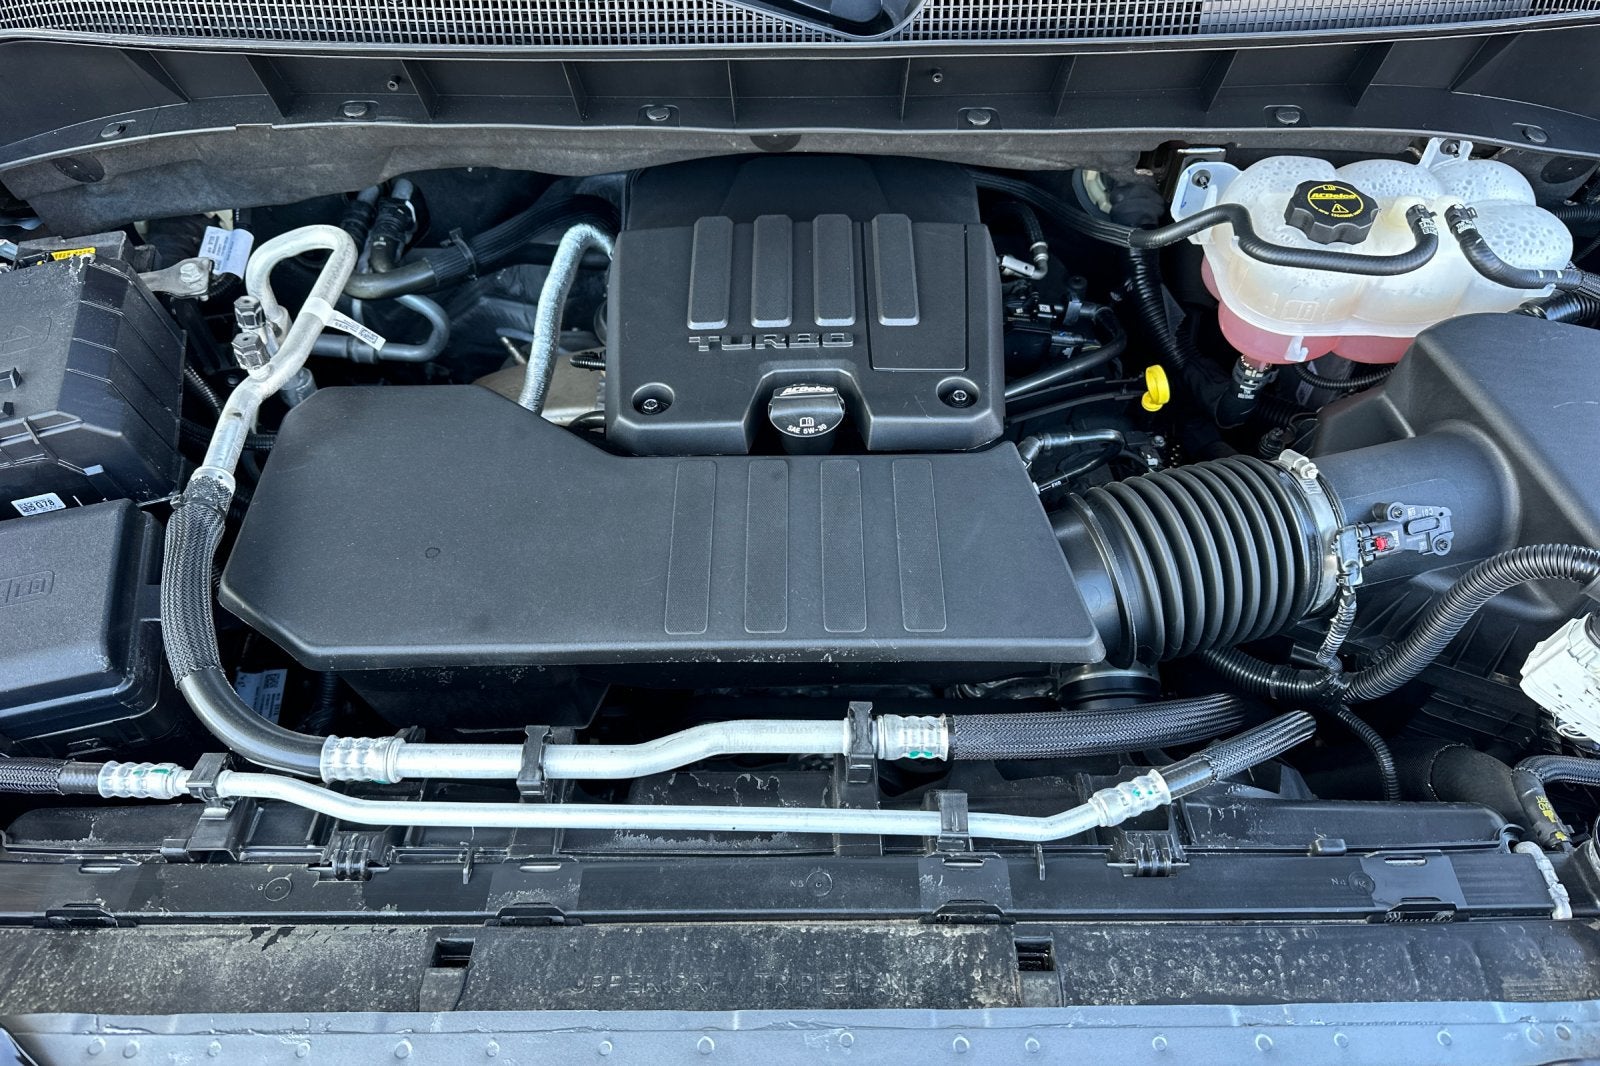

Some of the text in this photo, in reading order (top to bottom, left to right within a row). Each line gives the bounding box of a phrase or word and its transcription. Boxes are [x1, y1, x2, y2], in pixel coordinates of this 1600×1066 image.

[1310, 192, 1357, 200] ACDelco
[688, 333, 854, 352] TURBO
[780, 386, 835, 396] ACDelco
[787, 423, 828, 434] SAE 5W-30
